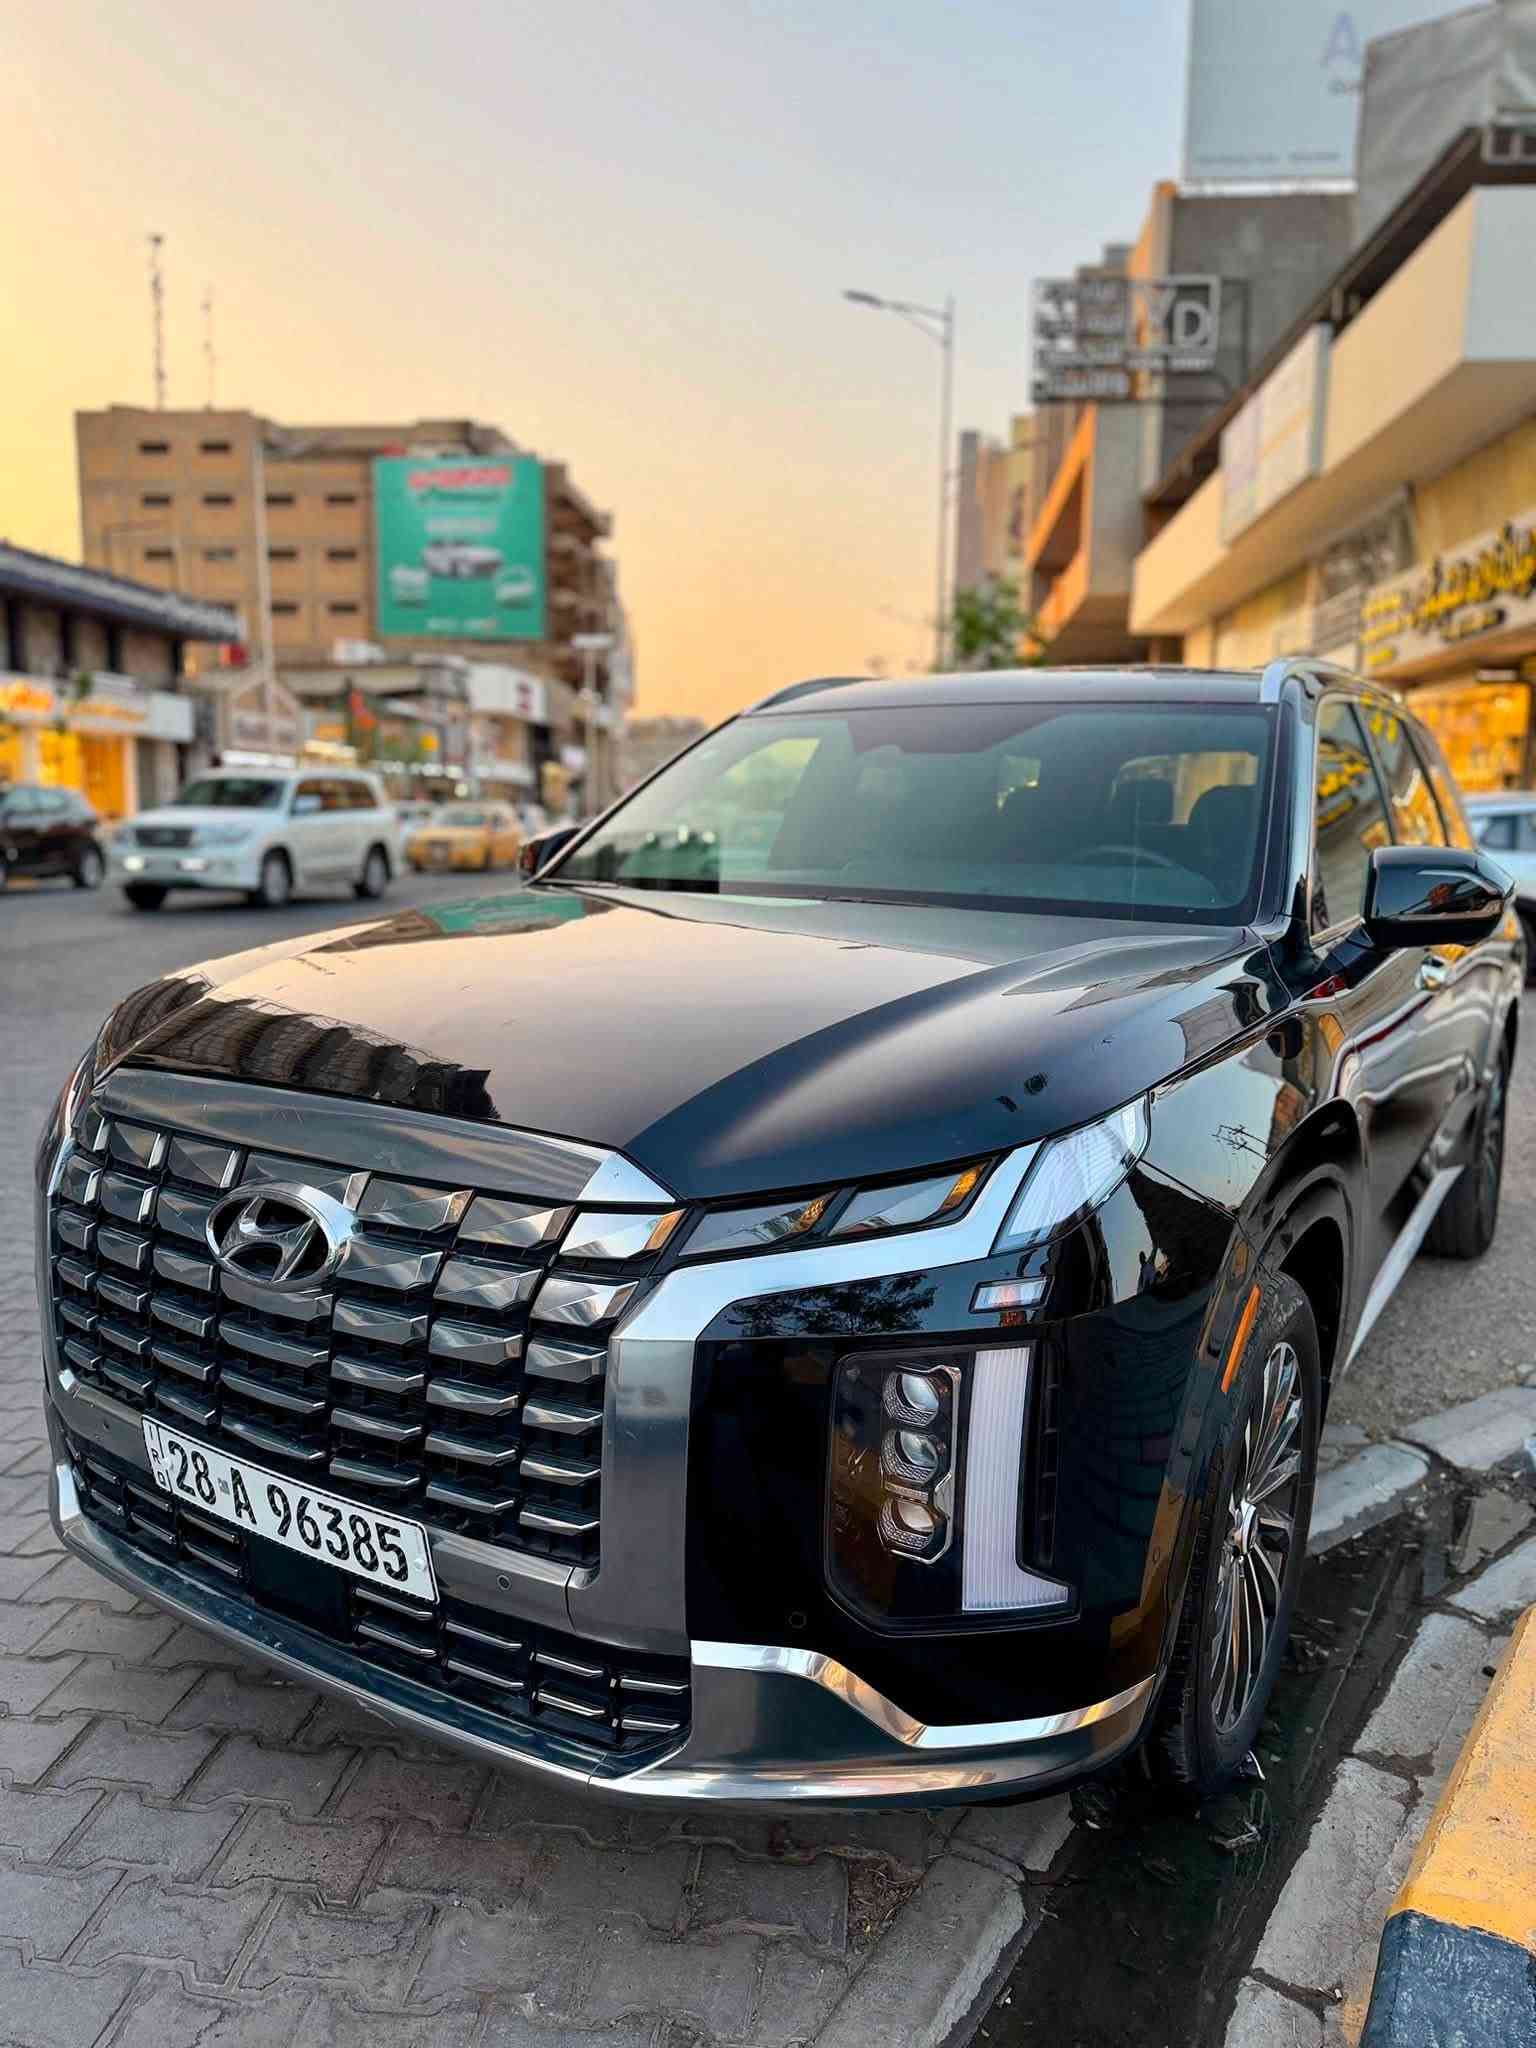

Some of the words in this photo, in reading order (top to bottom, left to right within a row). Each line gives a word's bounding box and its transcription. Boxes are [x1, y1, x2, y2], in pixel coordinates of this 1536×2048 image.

[168, 1440, 216, 1505] 28
[230, 1467, 257, 1525] A
[267, 1484, 409, 1582] 96385
